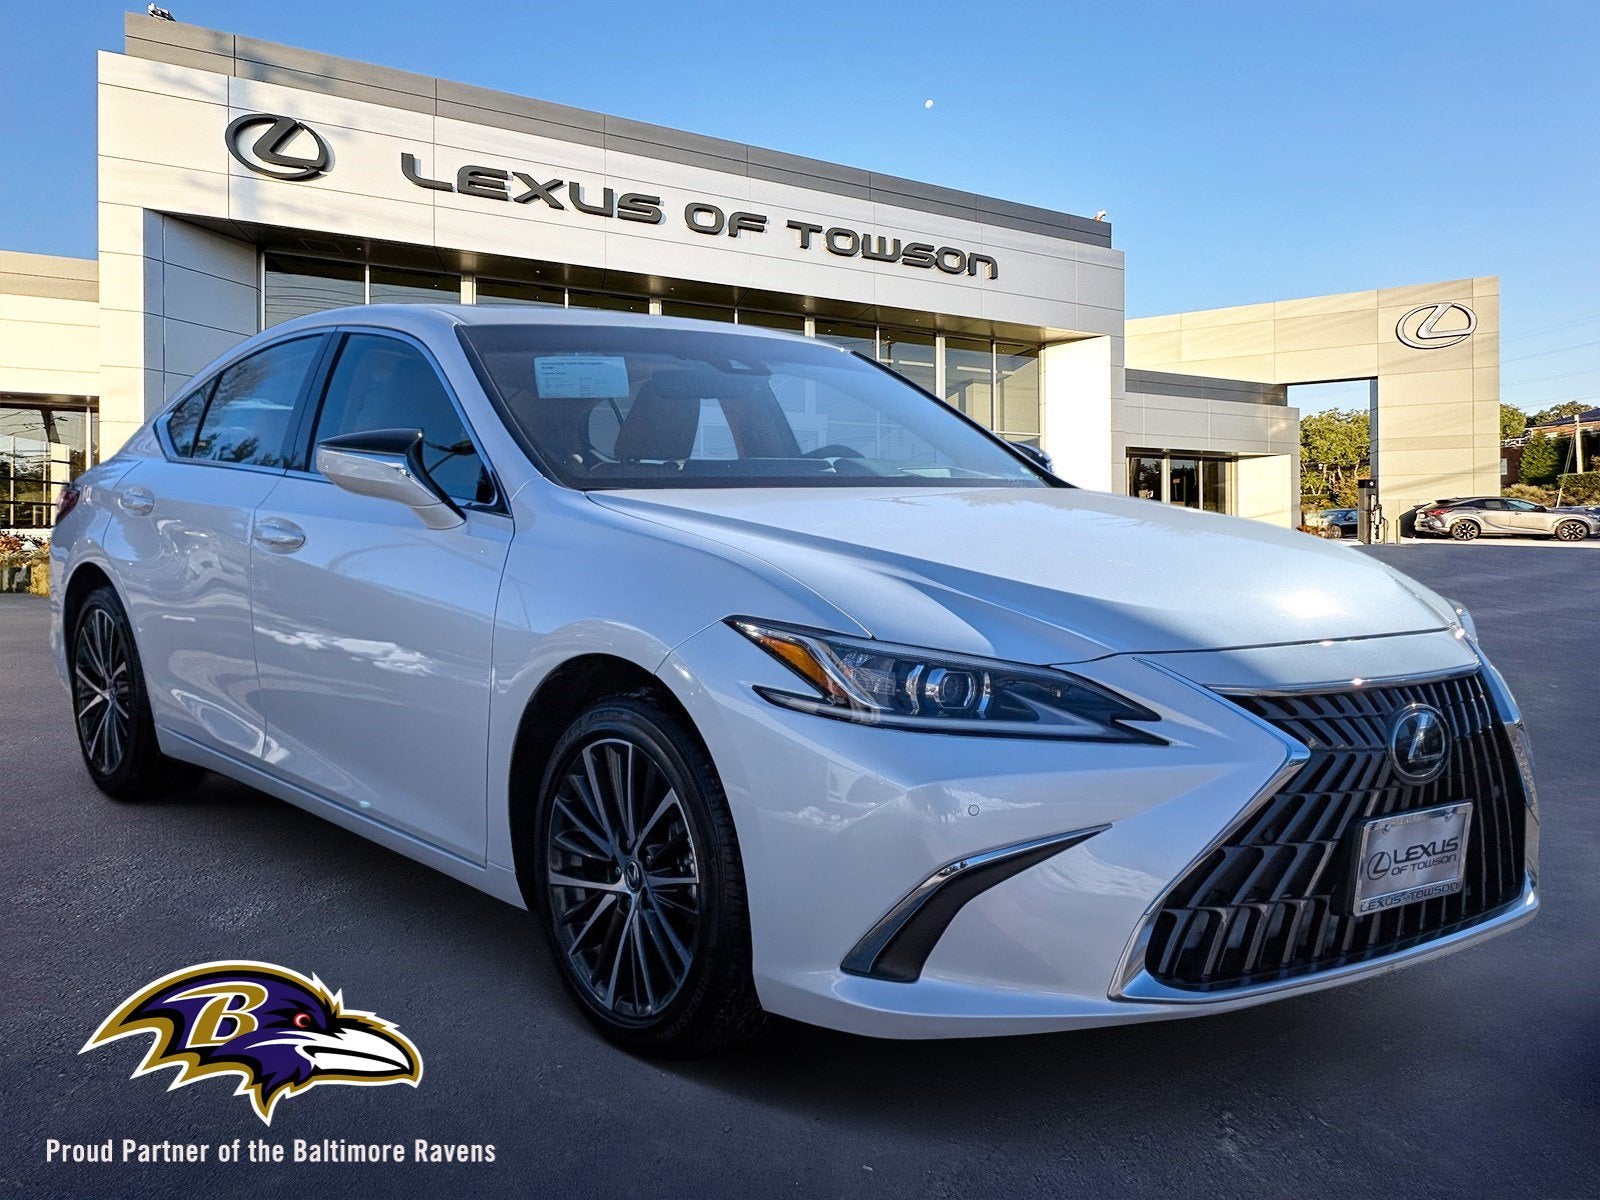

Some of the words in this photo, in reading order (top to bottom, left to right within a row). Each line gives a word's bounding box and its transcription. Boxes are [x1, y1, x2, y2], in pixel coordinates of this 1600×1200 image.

[400, 152, 664, 226] LEXUS
[684, 201, 769, 238] OF
[786, 219, 999, 281] TOWSON
[1391, 866, 1410, 876] OF
[1411, 853, 1457, 872] TOWSON
[1393, 836, 1459, 864] LEXUS
[1360, 894, 1402, 912] LEXUS
[1409, 881, 1459, 901] TOWSON
